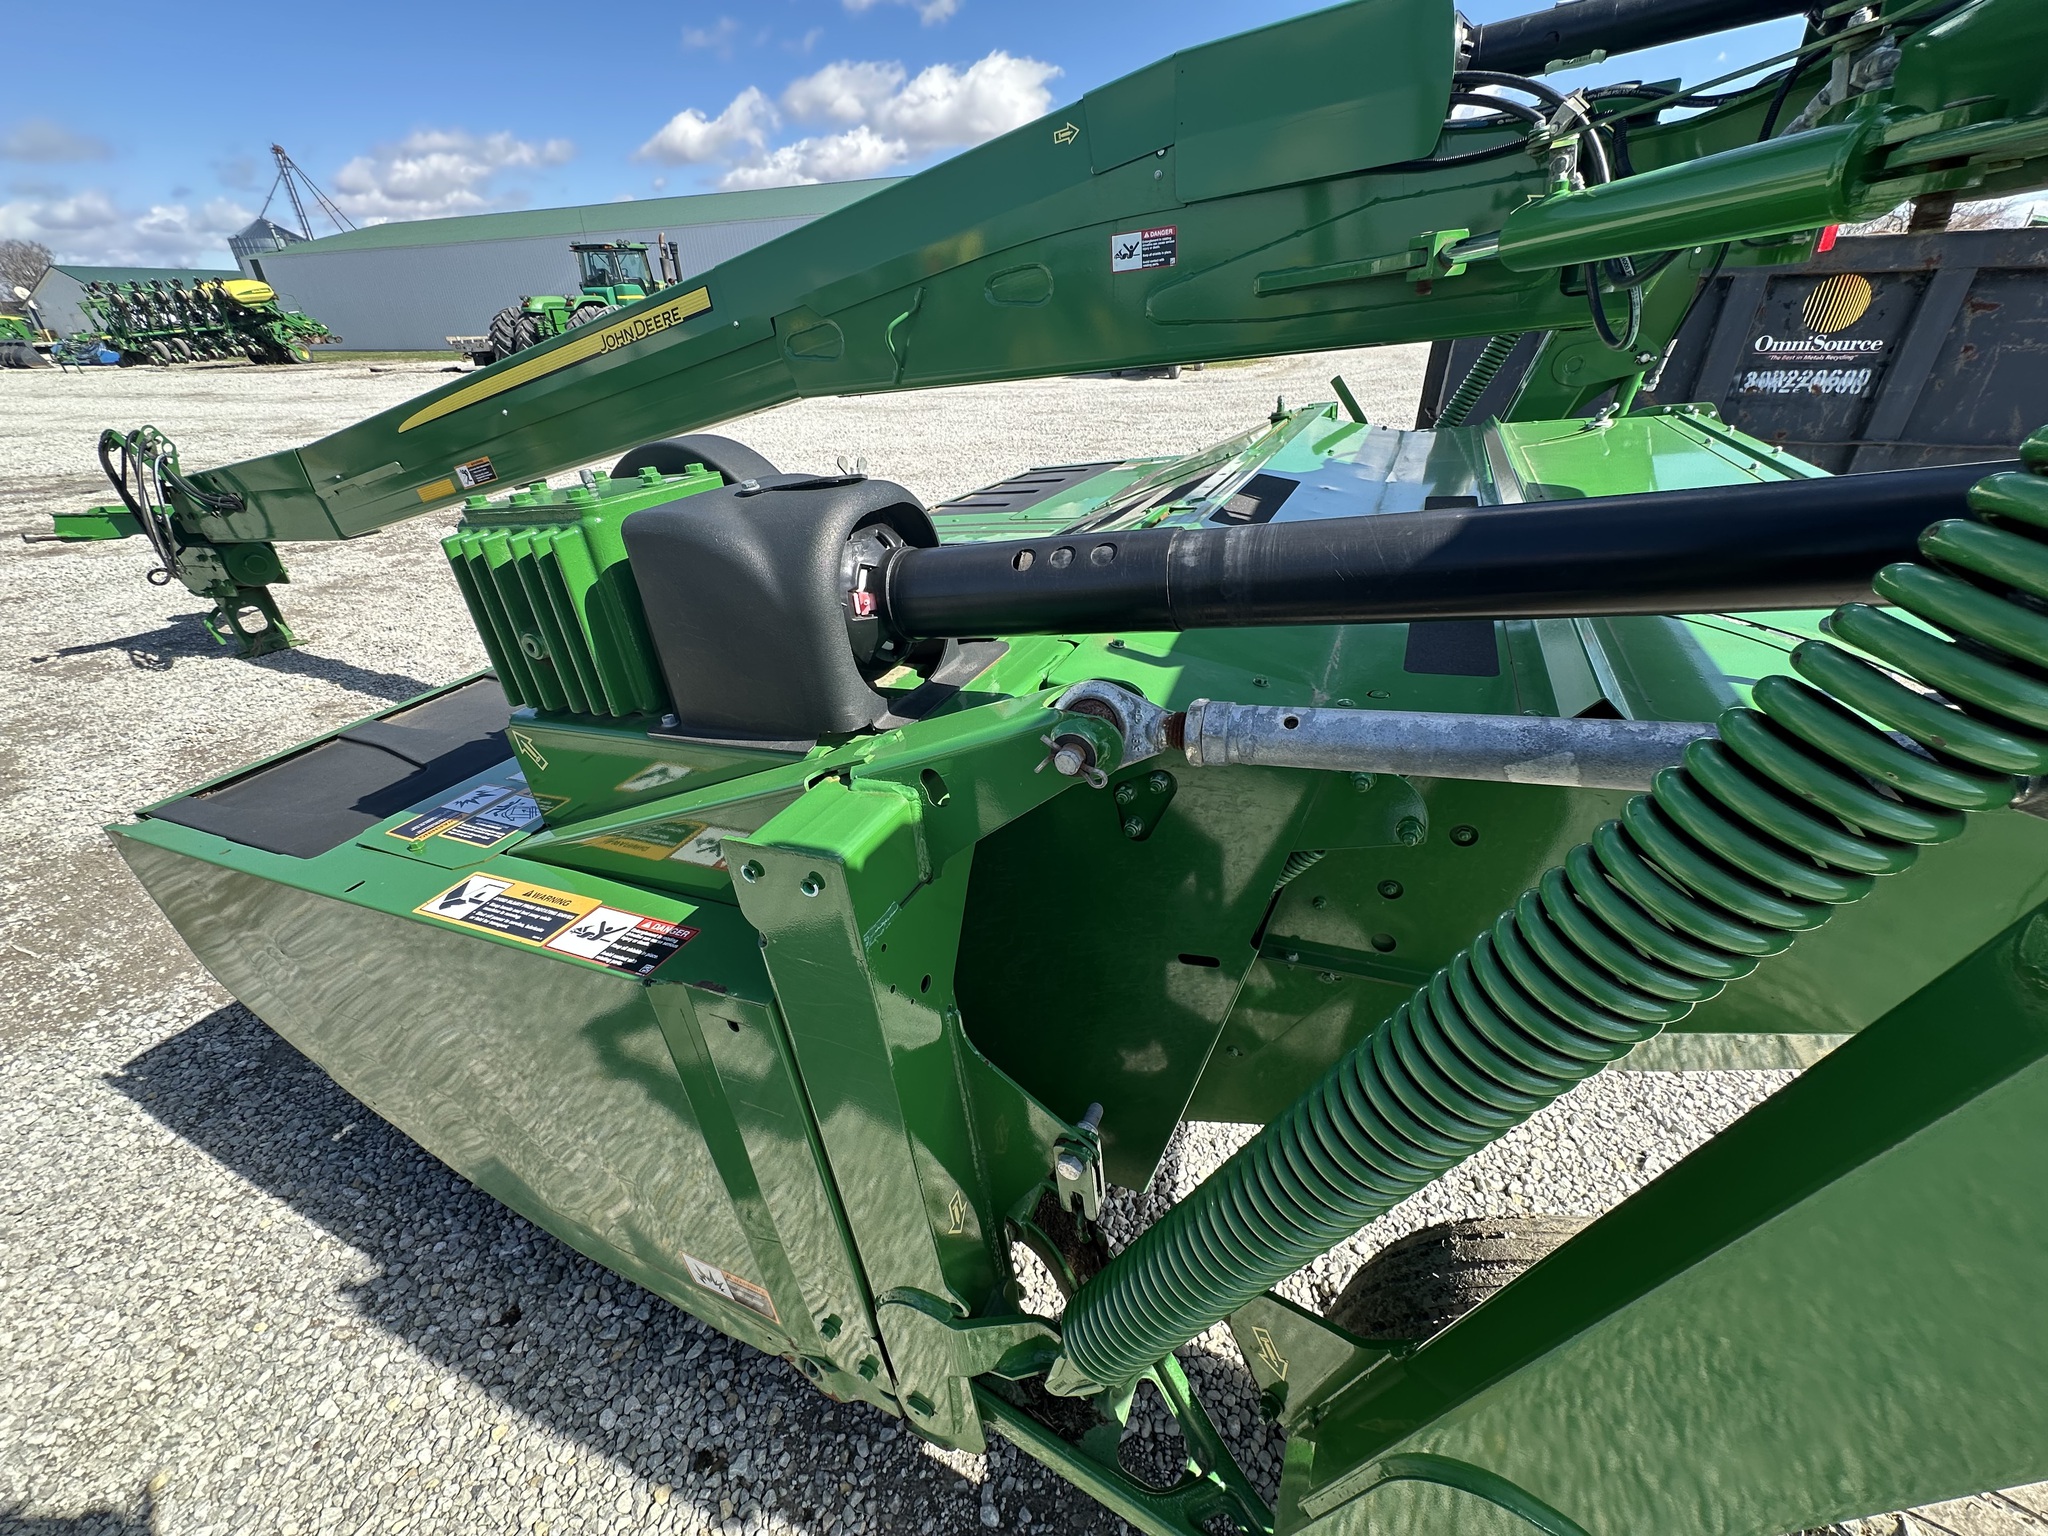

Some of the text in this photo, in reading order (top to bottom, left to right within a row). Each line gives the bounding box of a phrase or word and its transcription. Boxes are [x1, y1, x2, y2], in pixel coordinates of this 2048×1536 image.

[1150, 229, 1173, 237] DANGER
[600, 307, 682, 352] JOHN DEERE
[1754, 334, 1884, 352] OmniSource
[532, 892, 573, 907] WARNING
[651, 922, 691, 938] DANGER
